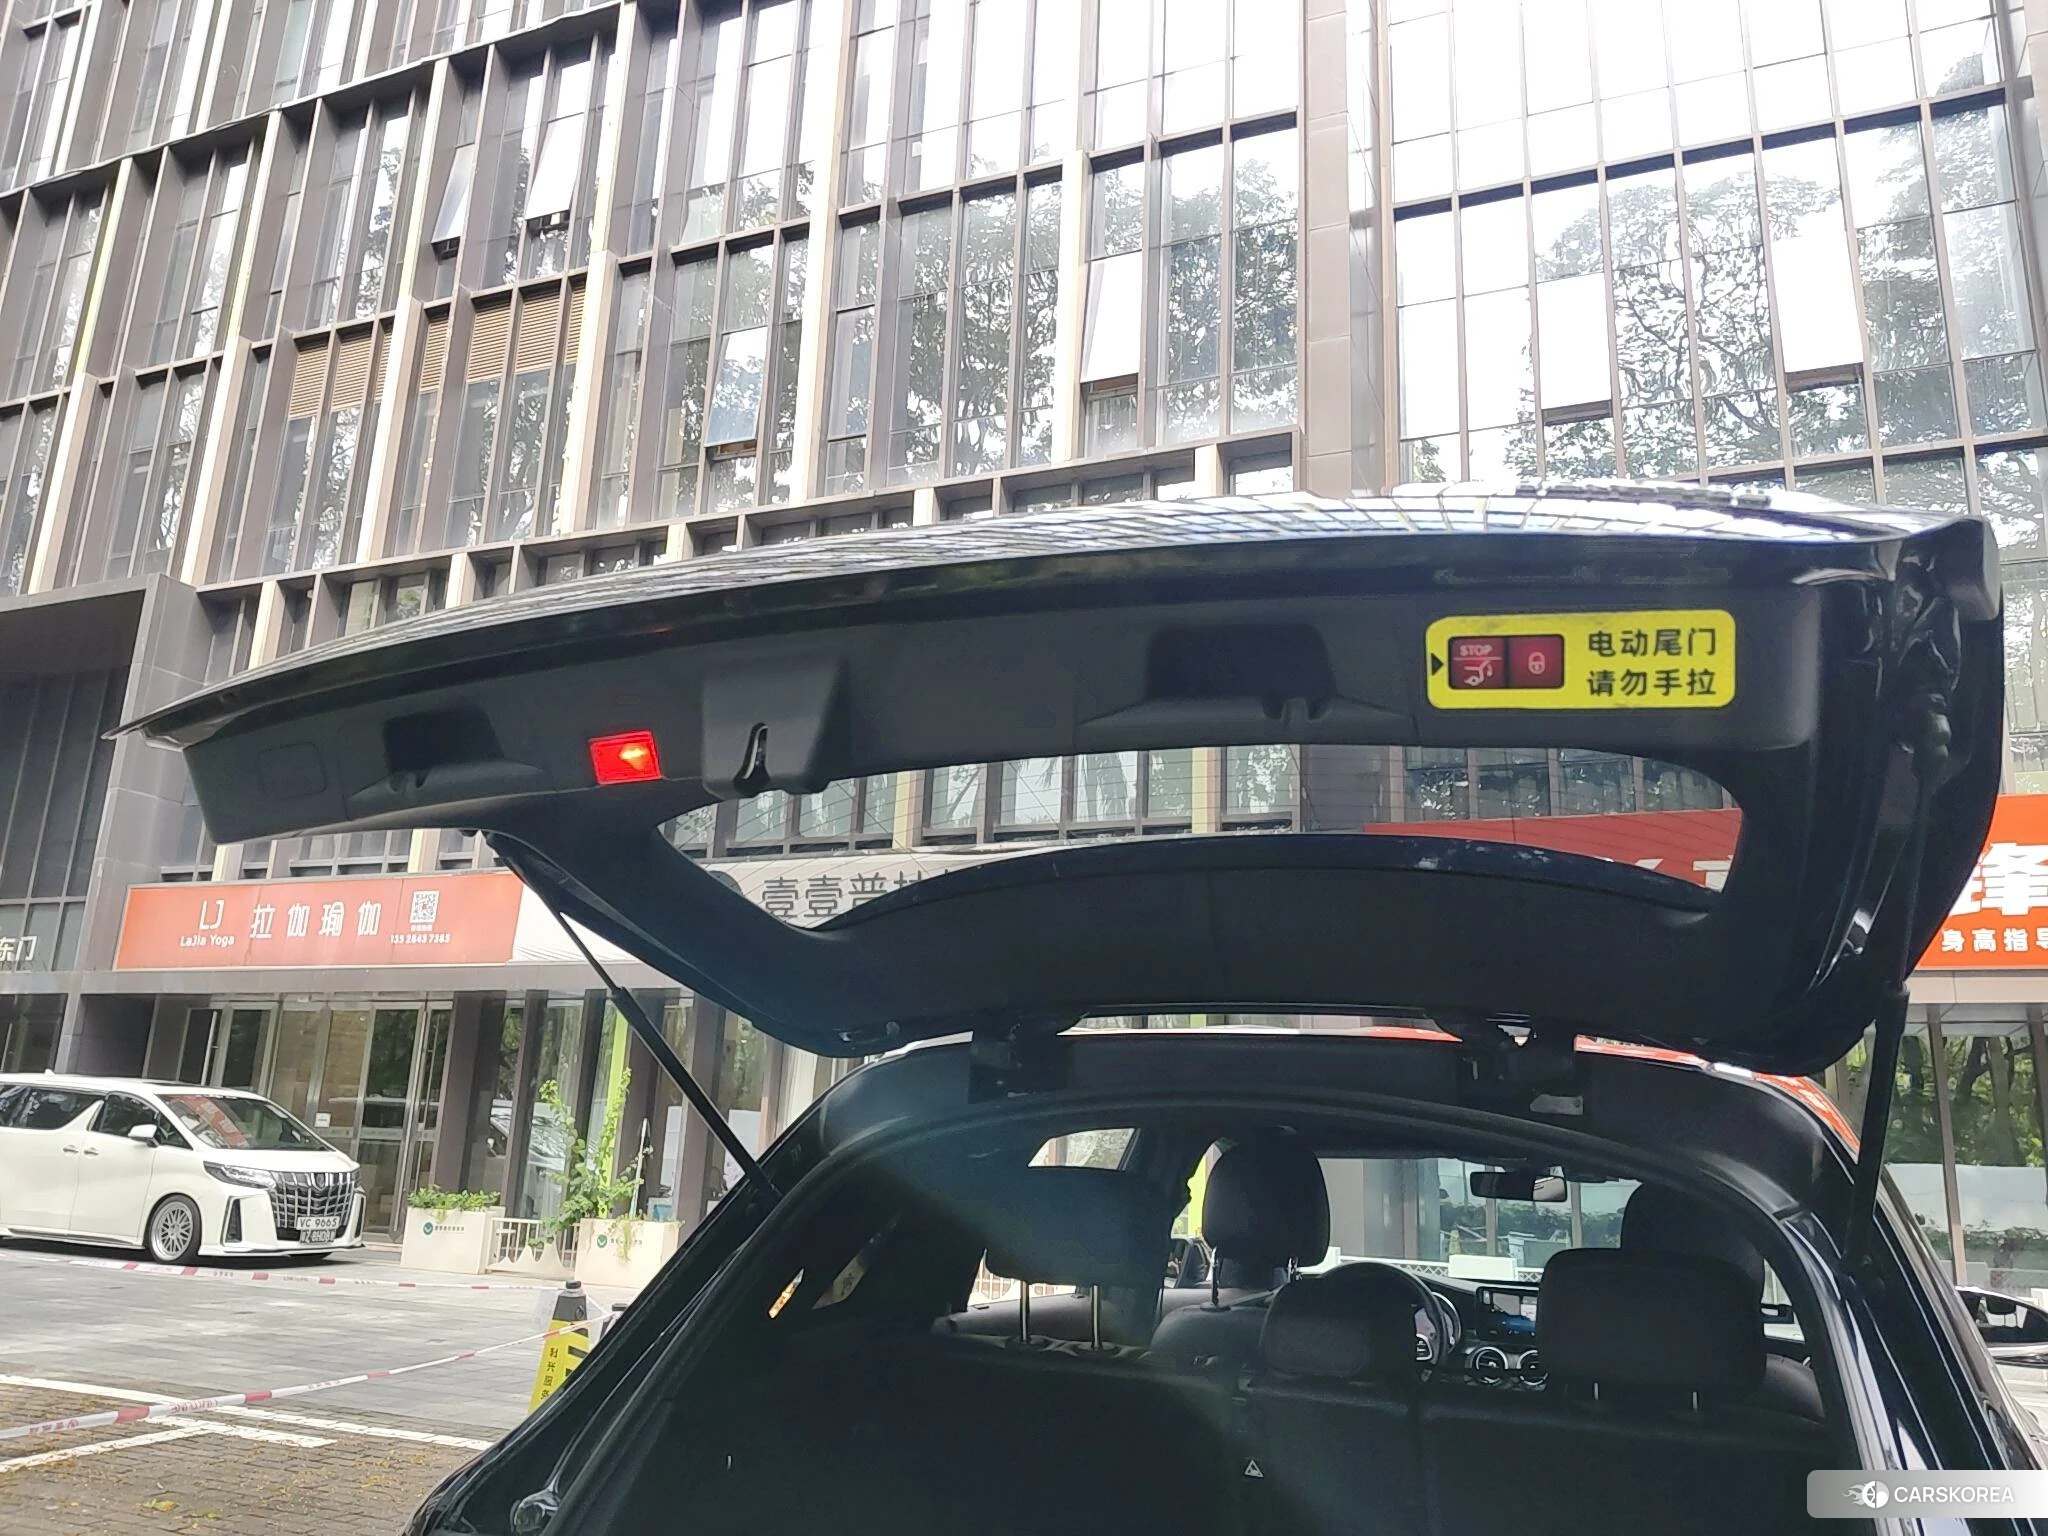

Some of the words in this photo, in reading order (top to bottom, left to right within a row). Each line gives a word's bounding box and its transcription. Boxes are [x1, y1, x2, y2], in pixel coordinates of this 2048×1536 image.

[1460, 643, 1493, 657] STOP
[1588, 629, 1716, 657] 电动尾门
[1587, 668, 1716, 696] 请勿手拉
[762, 869, 948, 917] 壹壹普
[250, 902, 382, 937] 拉伽瑜伽
[210, 934, 235, 948] Yoga
[300, 1219, 311, 1227] VC
[315, 1218, 337, 1227] 9665
